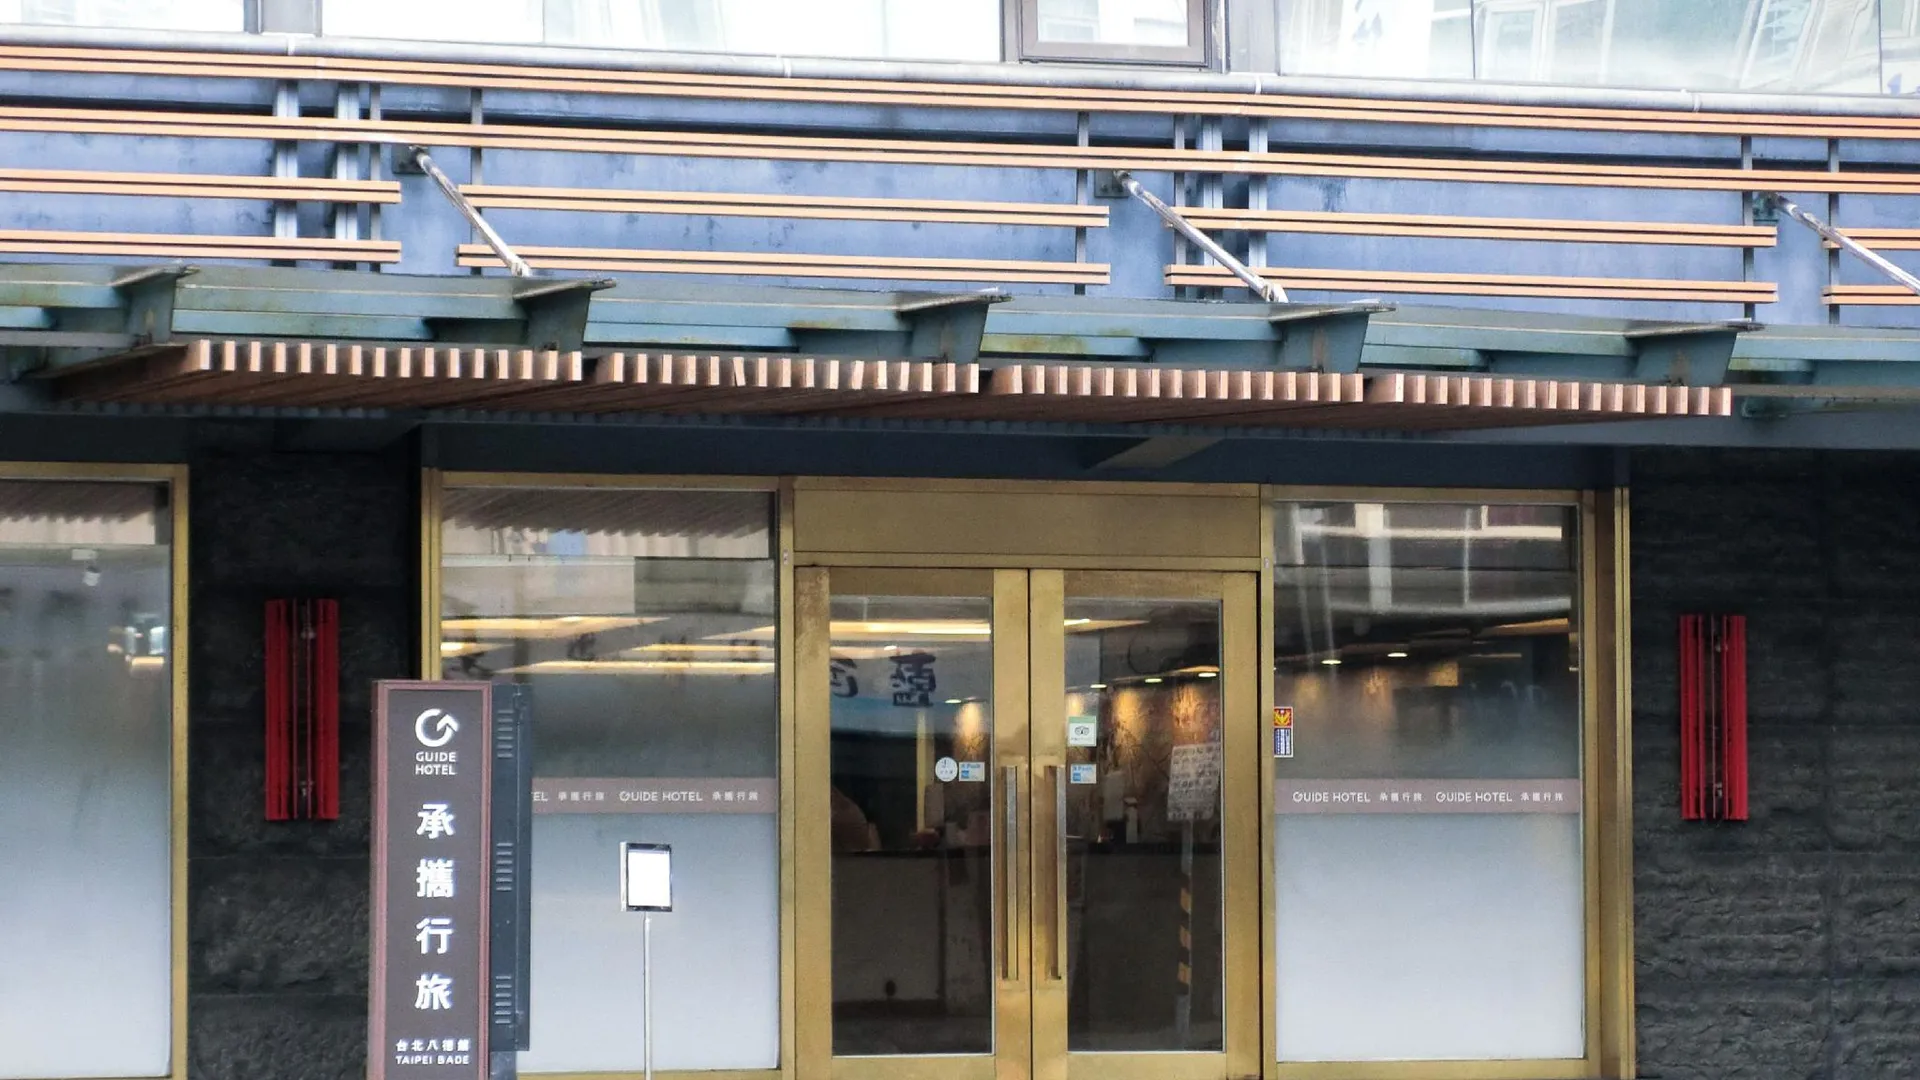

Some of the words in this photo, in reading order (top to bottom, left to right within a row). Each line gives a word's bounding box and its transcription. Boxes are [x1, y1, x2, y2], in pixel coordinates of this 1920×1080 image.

[415, 751, 457, 762] GUIDE
[415, 764, 457, 775] HOTEL
[619, 791, 659, 802] GUIDE
[662, 791, 703, 802] HOTEL
[1292, 791, 1329, 802] GUIDE
[1332, 791, 1371, 802] HOTEL
[1435, 791, 1472, 802] GUIDE
[1475, 791, 1513, 802] HOTEL
[415, 803, 455, 1010] 承攜行旅
[395, 1055, 432, 1065] TAIPEI
[437, 1055, 470, 1065] BADE
